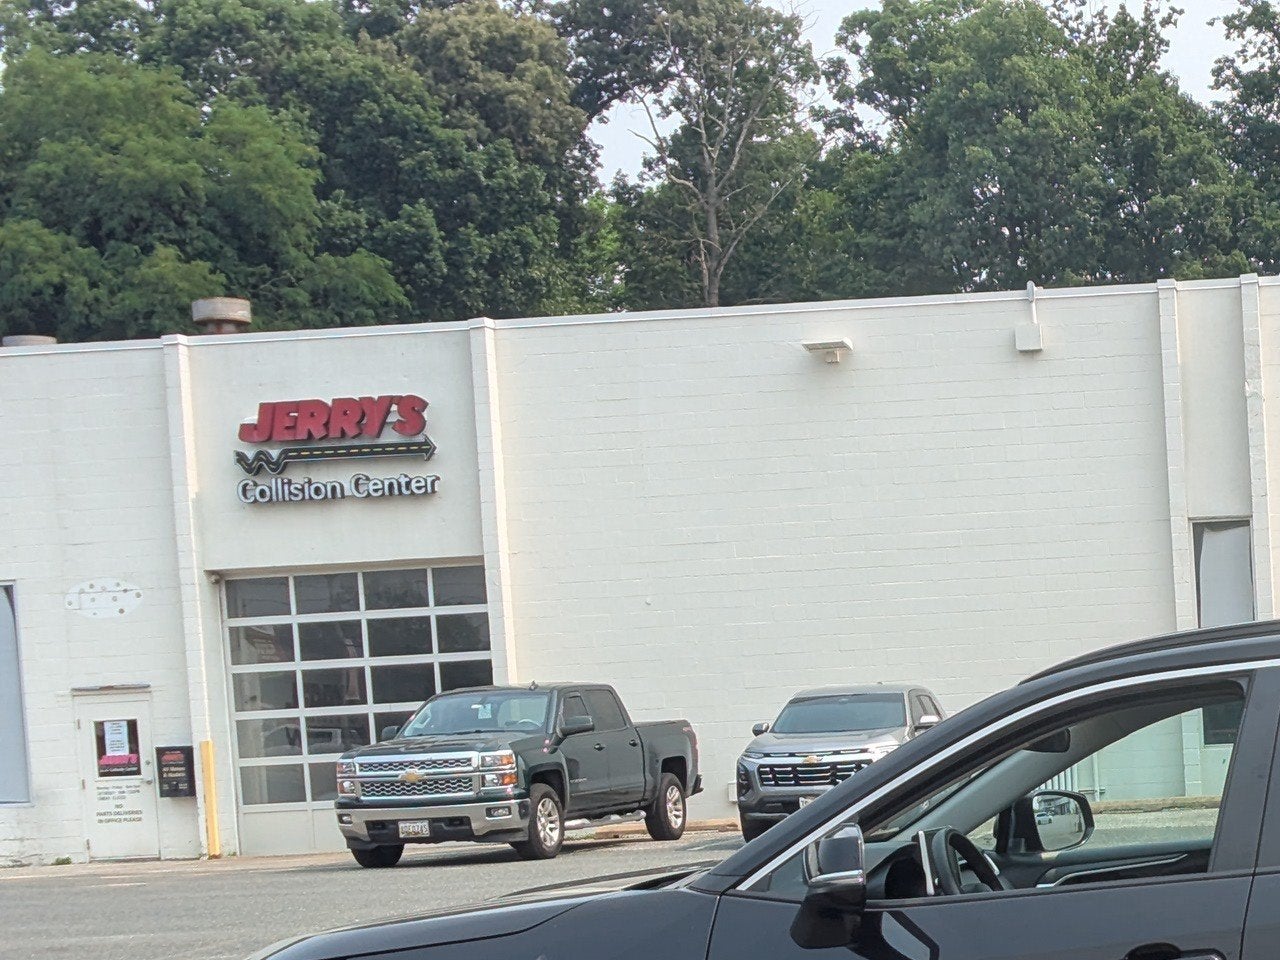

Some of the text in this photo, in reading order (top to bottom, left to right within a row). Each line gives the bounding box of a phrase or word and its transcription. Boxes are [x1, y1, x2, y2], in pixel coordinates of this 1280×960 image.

[238, 394, 429, 443] JERRY'S
[237, 473, 440, 504] Collision Center
